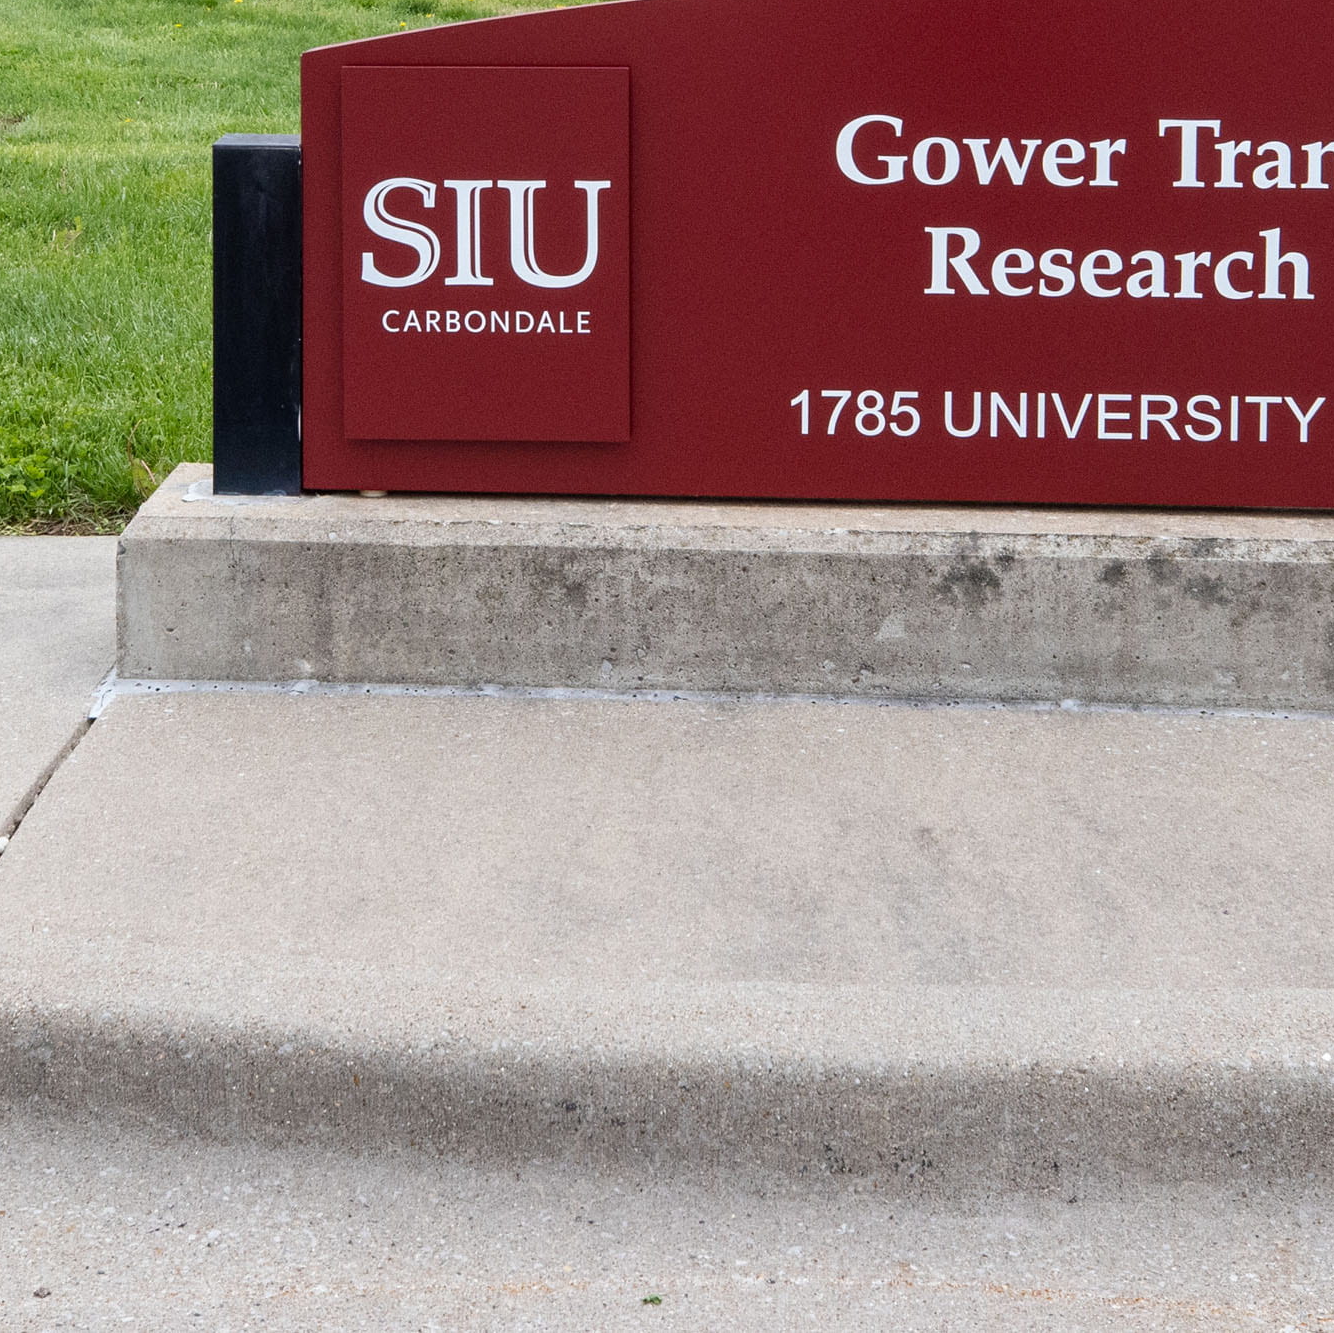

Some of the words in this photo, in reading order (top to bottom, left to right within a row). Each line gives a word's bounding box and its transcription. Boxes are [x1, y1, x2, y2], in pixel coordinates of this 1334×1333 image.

[835, 114, 1127, 187] Gower
[361, 177, 612, 289] SIU
[923, 226, 1315, 300] Research
[382, 309, 591, 334] CARBONDALE
[790, 389, 921, 437] 1785
[944, 390, 1326, 443] UNIVERSITY
